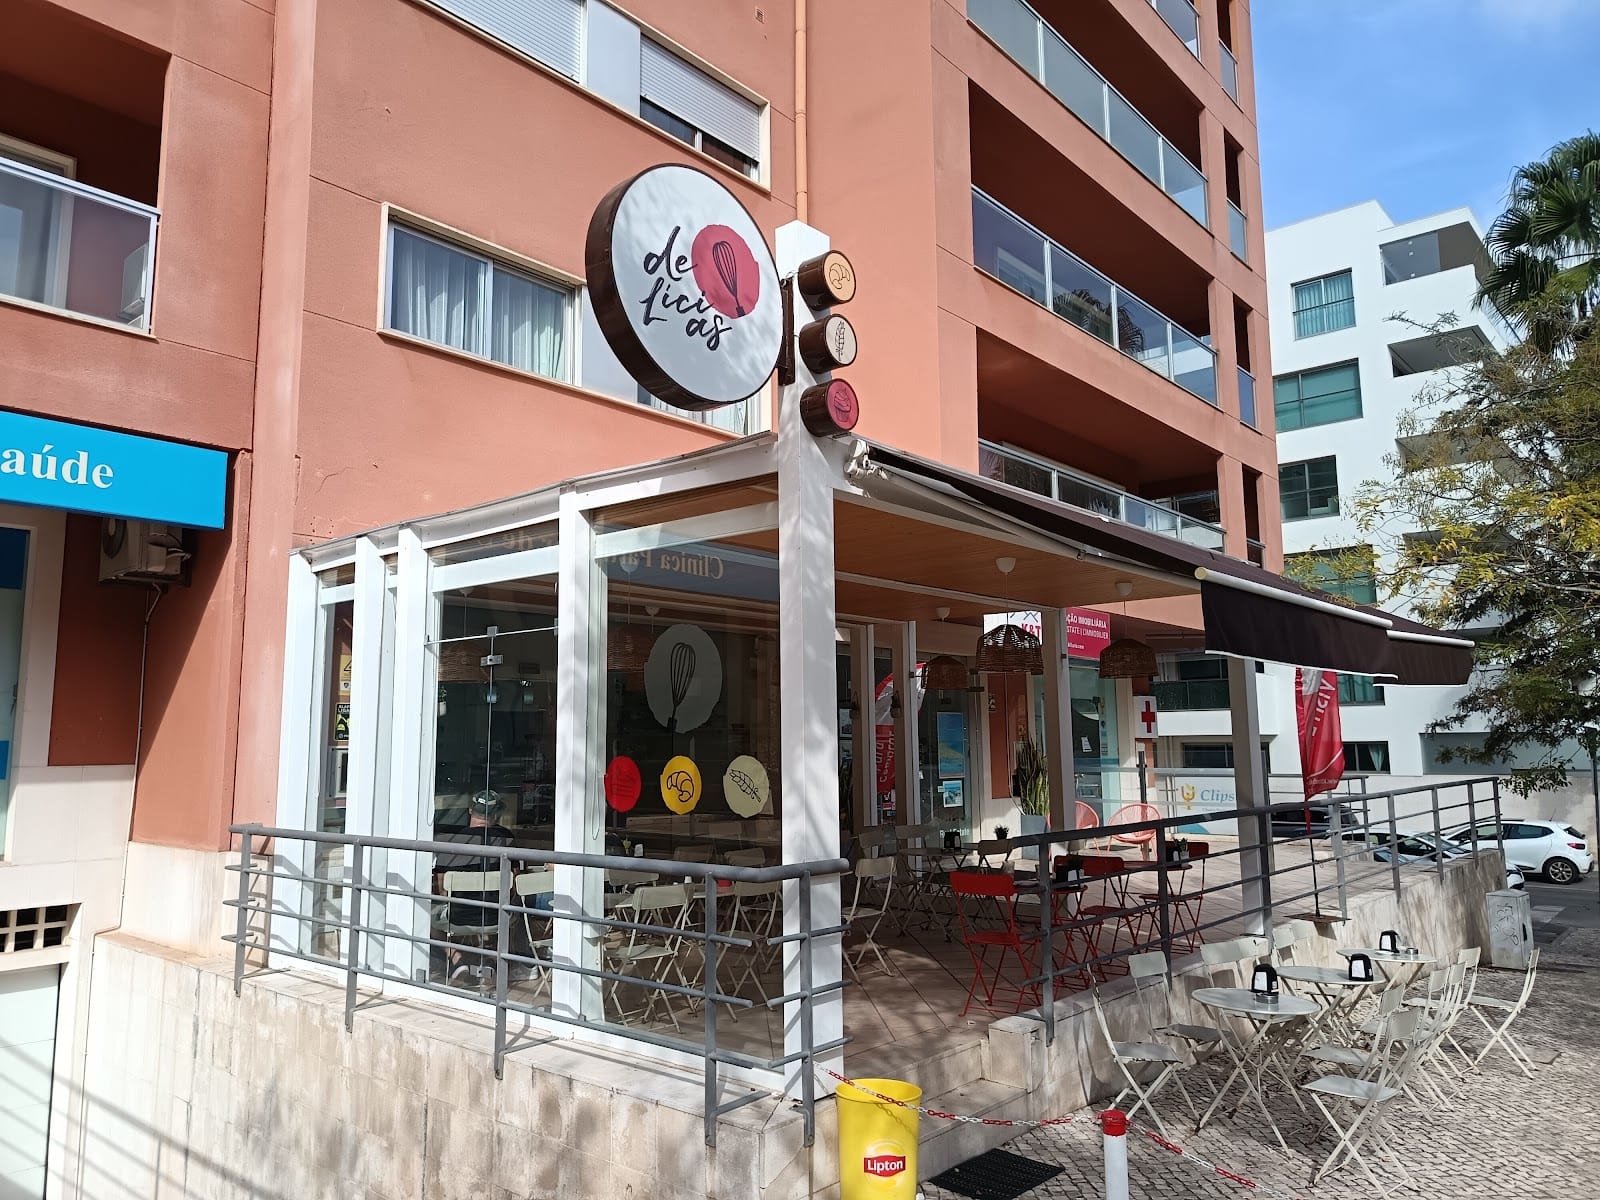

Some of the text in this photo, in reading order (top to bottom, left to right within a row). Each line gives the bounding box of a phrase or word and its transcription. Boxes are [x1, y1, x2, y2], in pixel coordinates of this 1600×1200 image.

[643, 225, 697, 281] de
[685, 314, 732, 351] as
[1077, 615, 1107, 629] IMOBILIÁRIA
[1066, 625, 1081, 635] STATE
[867, 1159, 903, 1174] Lipton
